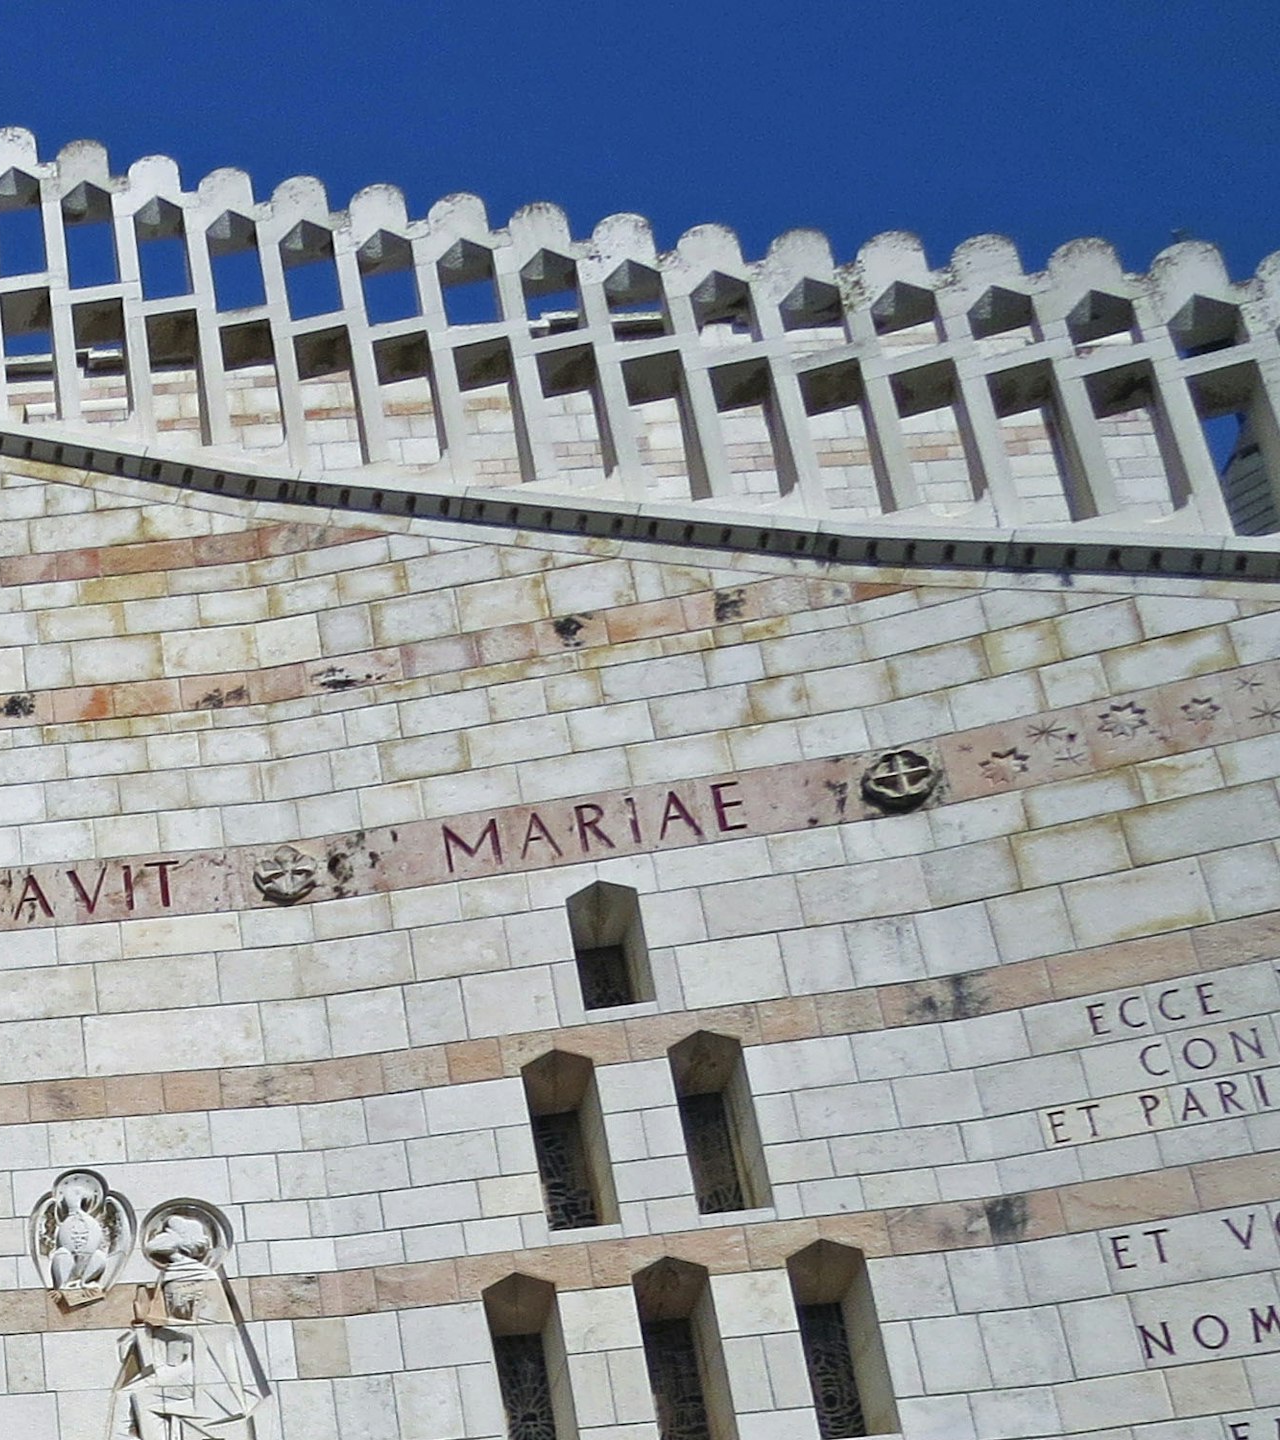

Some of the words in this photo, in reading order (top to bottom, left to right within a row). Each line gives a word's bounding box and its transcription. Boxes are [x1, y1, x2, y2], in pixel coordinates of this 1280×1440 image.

[441, 781, 747, 873] MARIAE
[1086, 983, 1223, 1036] ECCE
[1139, 1028, 1266, 1076] CON
[1047, 1104, 1100, 1144] ET
[1138, 1075, 1272, 1126] PARI
[1109, 1228, 1171, 1270] ET
